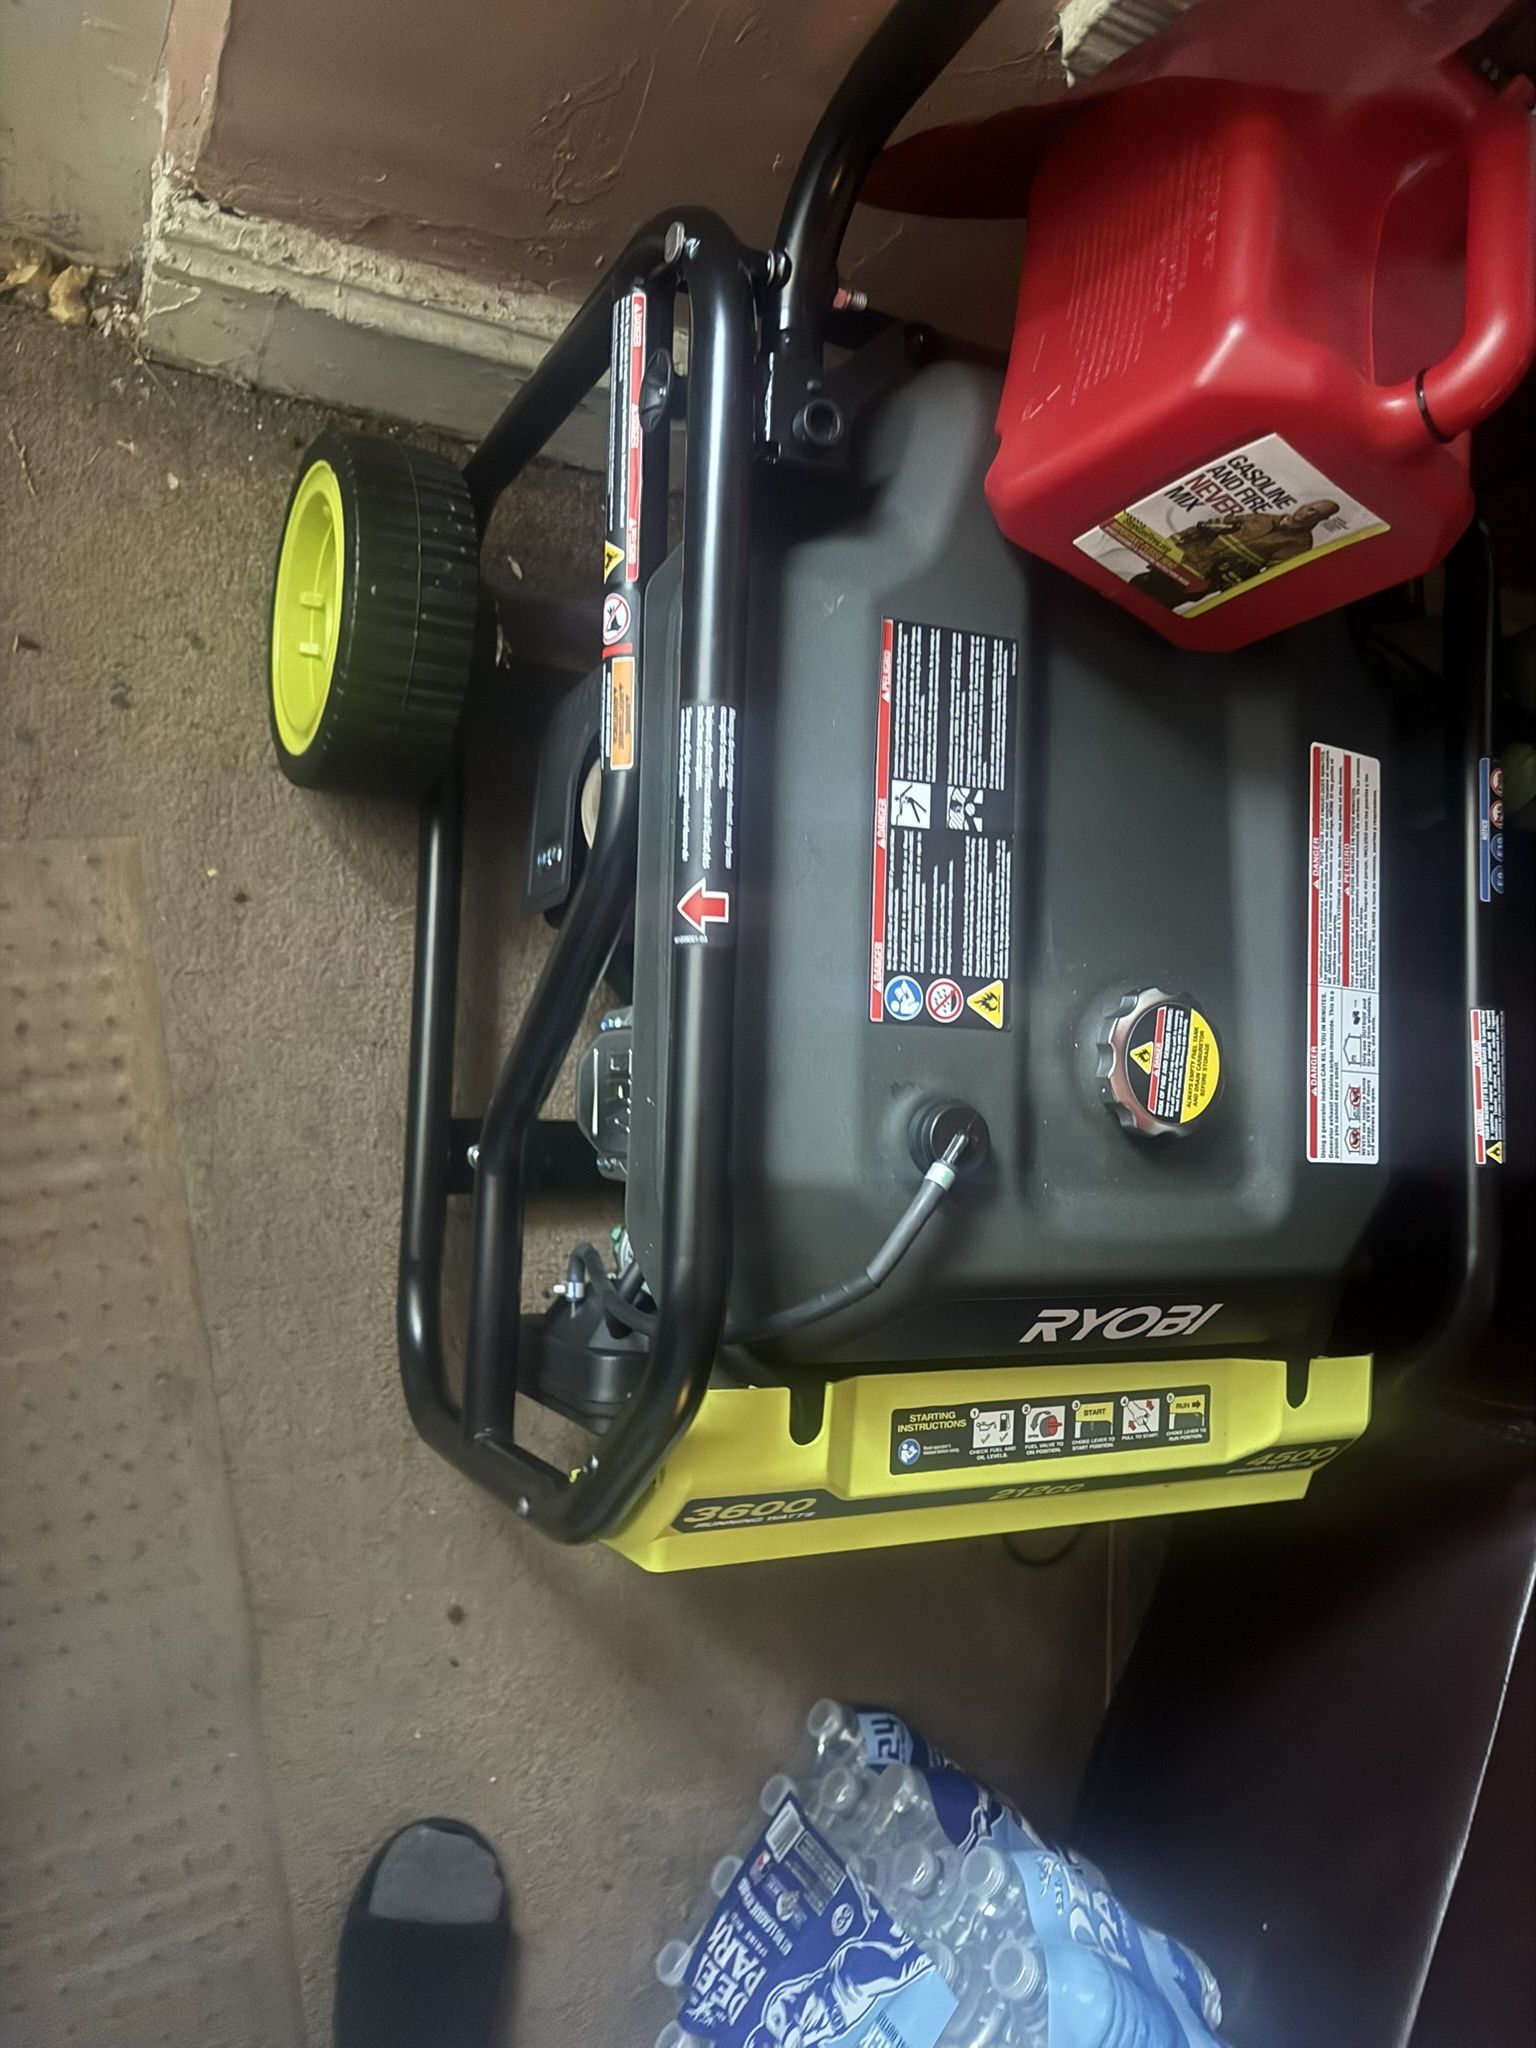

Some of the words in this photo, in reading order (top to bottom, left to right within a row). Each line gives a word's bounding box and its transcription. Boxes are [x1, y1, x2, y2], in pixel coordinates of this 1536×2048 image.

[1205, 466, 1244, 491] AND
[1234, 486, 1273, 513] FIRE
[1228, 455, 1298, 510] GASOLINE
[1164, 485, 1206, 512] MIX
[1184, 473, 1245, 519] NEVER
[1196, 1030, 1205, 1072] CARBURETOR
[1202, 1044, 1210, 1072] STORAGE
[1186, 1082, 1194, 1108] ALWAYS
[1019, 1303, 1224, 1343] RYOBI
[910, 1411, 956, 1423] STARTING
[1083, 1408, 1106, 1417] START
[897, 1419, 967, 1433] INSTRUCTIONS
[969, 1448, 989, 1456] CHECK
[1246, 1447, 1338, 1466] 4500
[987, 1483, 1085, 1500] 212cc
[683, 1498, 817, 1523] 3600
[693, 1517, 763, 1528] RUNNING
[767, 1512, 816, 1521] WATTS
[871, 1719, 900, 1760] 24
[749, 1901, 778, 1937] LEAGUE
